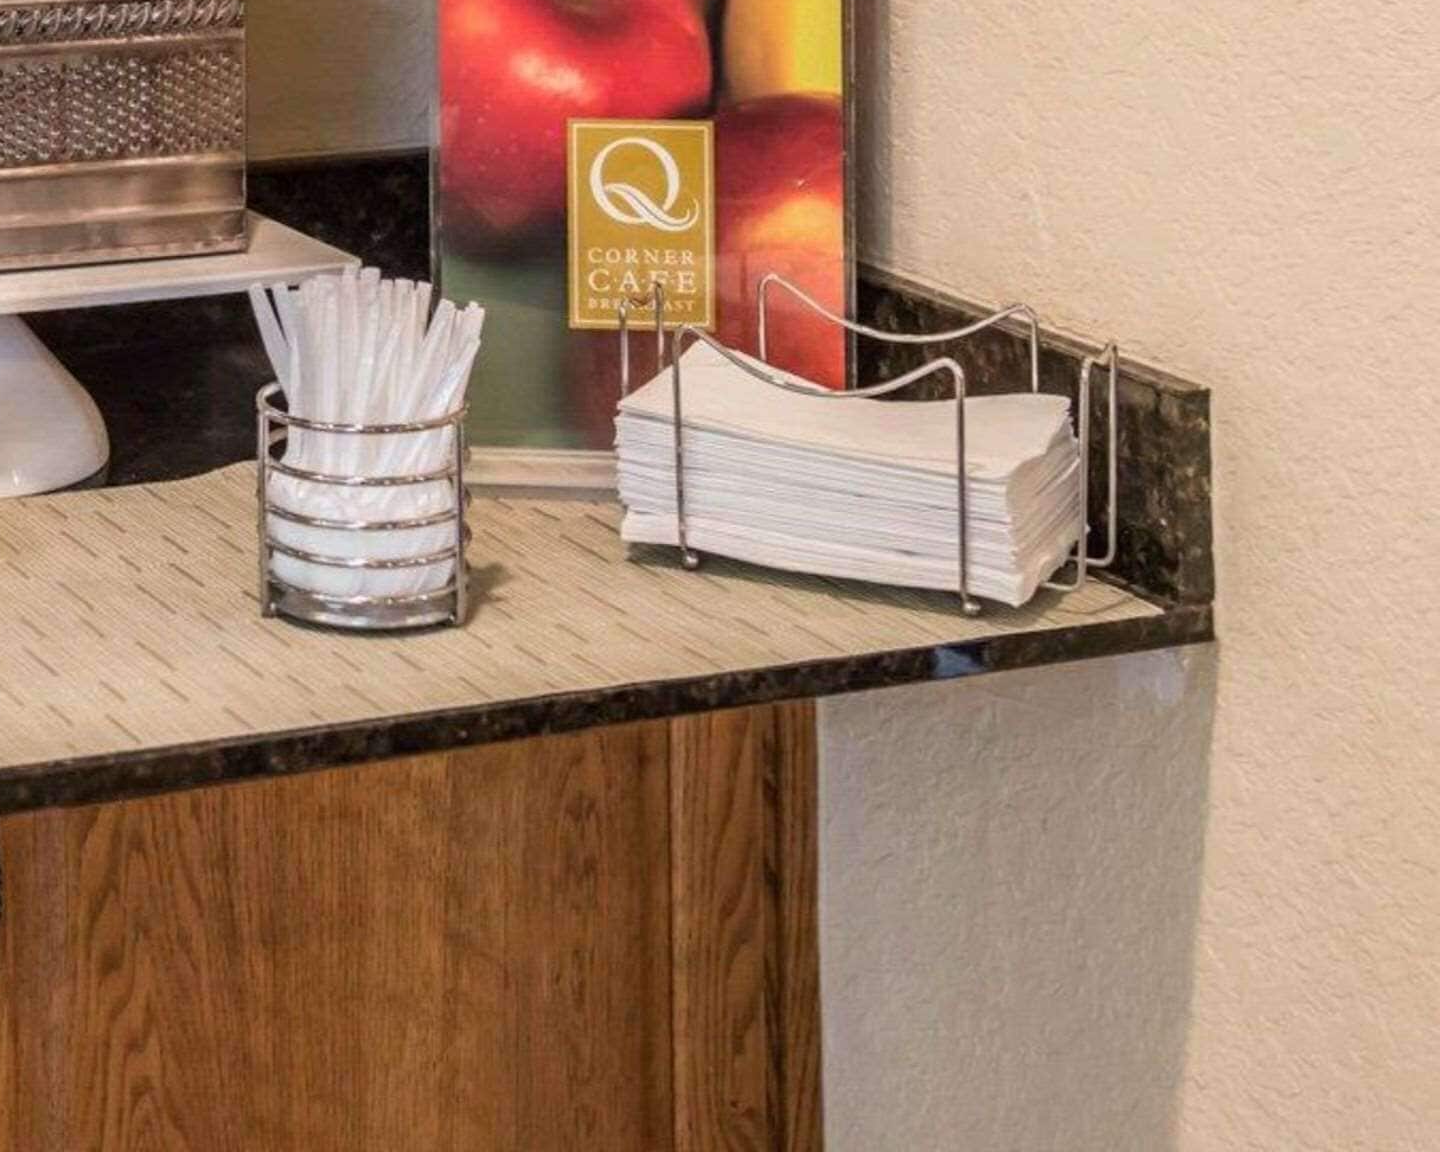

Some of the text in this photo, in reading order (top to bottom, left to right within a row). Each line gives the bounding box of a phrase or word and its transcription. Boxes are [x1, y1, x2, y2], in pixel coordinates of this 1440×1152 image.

[589, 136, 701, 233] Q
[587, 247, 695, 265] CORNER
[587, 298, 695, 312] BREAST
